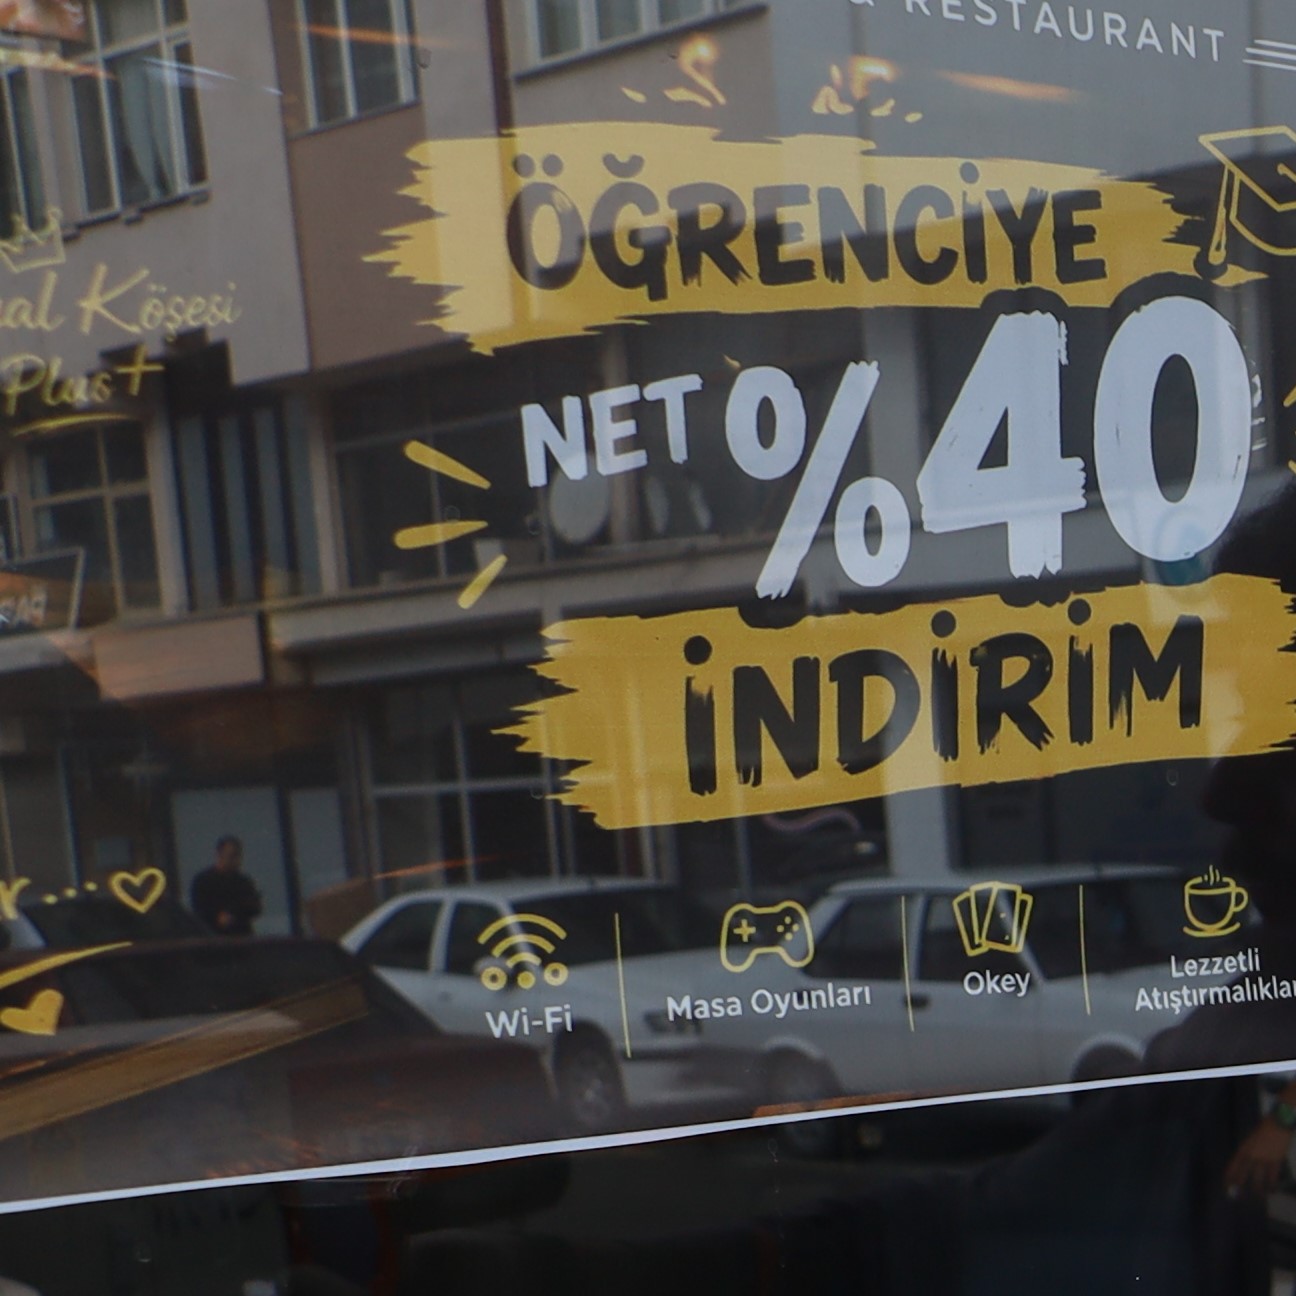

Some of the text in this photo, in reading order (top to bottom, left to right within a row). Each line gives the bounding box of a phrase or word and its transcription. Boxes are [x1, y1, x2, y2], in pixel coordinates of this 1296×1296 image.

[505, 151, 1108, 301] ÖĞRENCİYE
[0, 262, 241, 342] al Köşesi
[520, 296, 1253, 600] NET %40
[683, 598, 1204, 796] İNDİRİM
[963, 969, 1031, 998] Okey
[1170, 947, 1261, 979] Lezzetli
[485, 1004, 574, 1038] Wi-Fi
[666, 982, 871, 1022] Masa Oyunları
